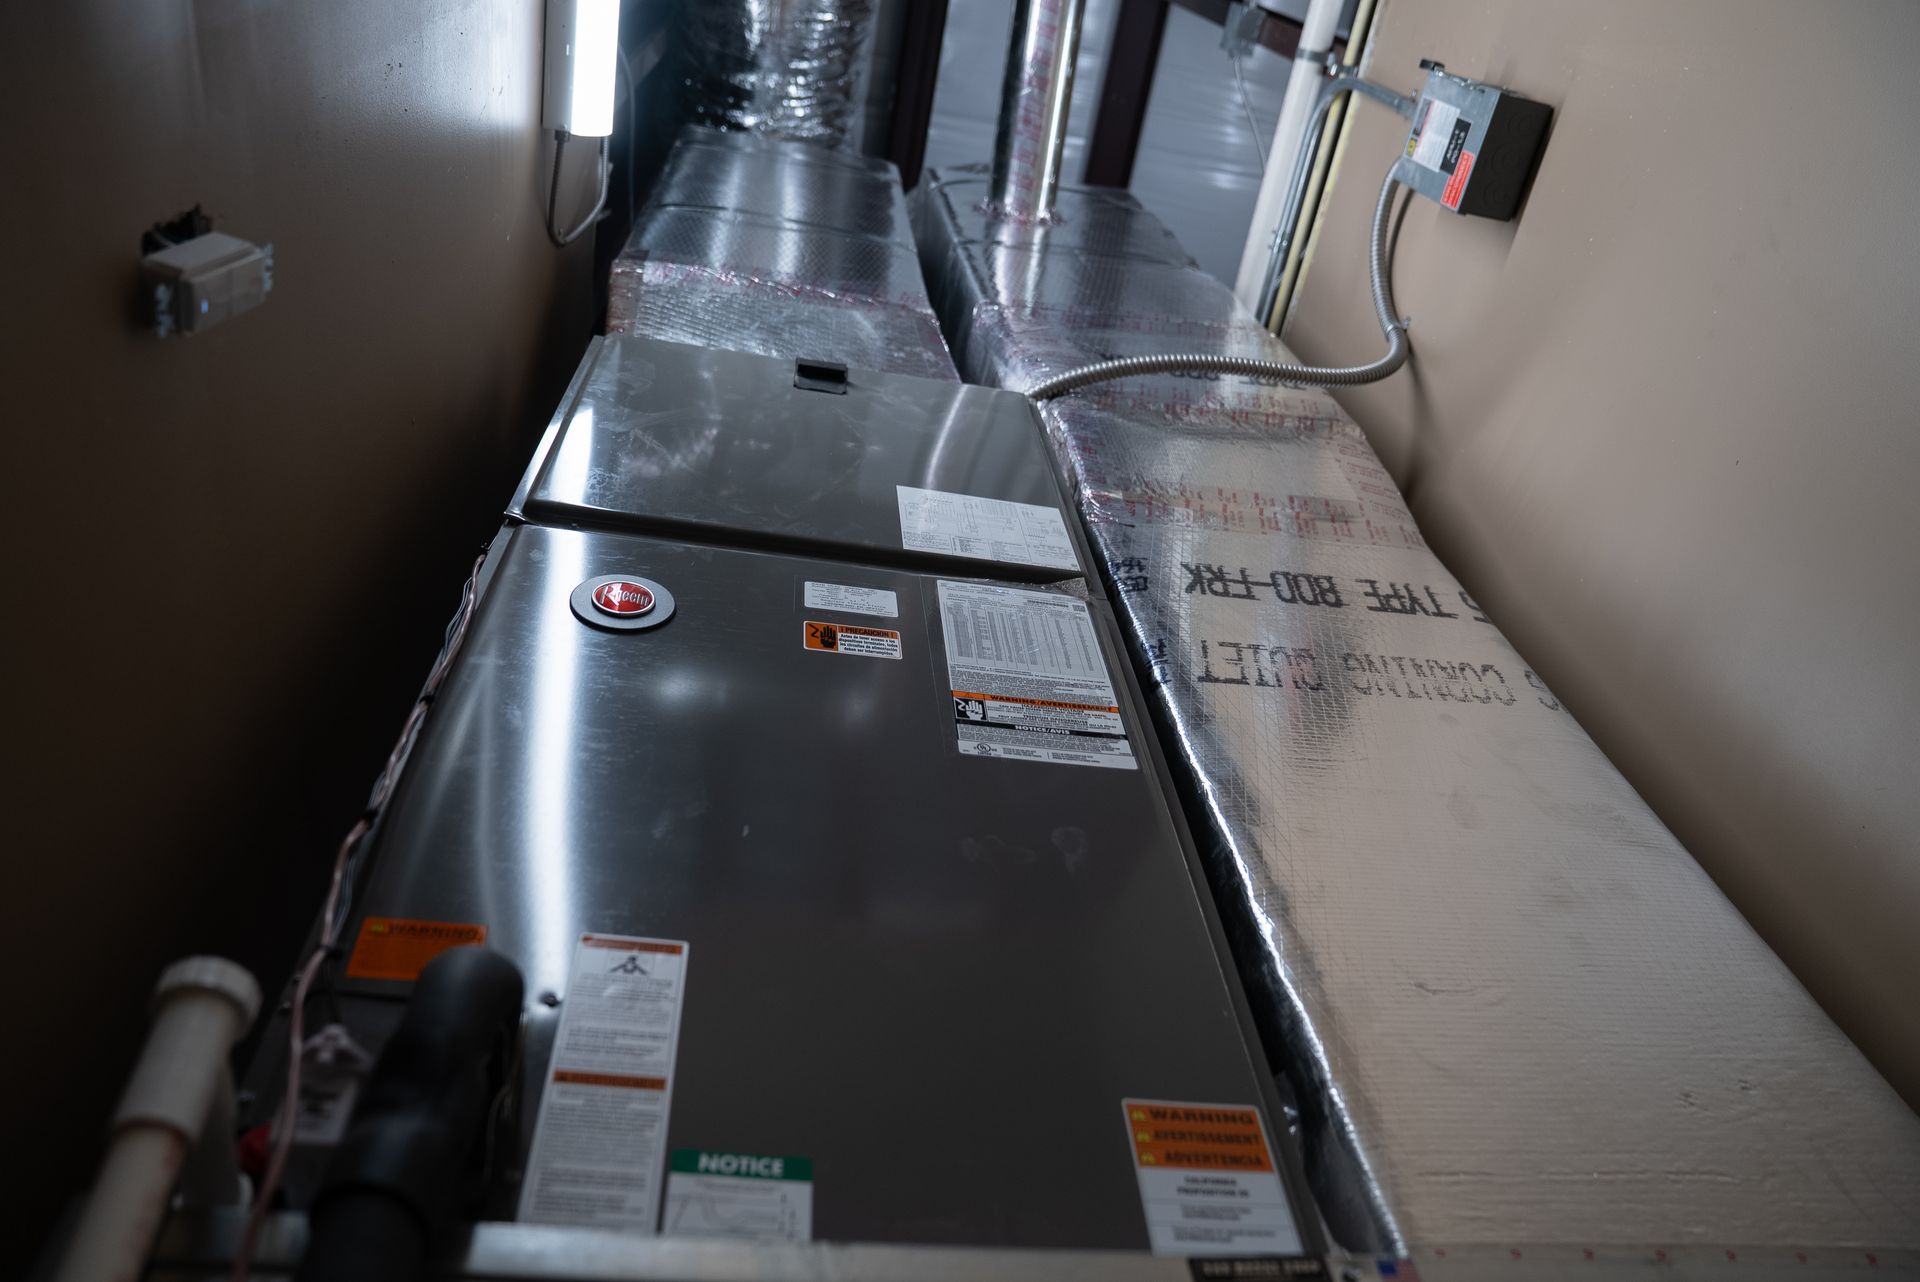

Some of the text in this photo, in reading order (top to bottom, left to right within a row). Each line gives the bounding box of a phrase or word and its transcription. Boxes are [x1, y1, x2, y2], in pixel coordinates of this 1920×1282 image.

[1181, 562, 1350, 608] 800-FRK
[1355, 577, 1459, 620] TYPE
[1344, 652, 1517, 706] CORNING
[388, 923, 479, 940] WARNING
[1150, 1109, 1254, 1124] WARNING
[698, 1152, 784, 1177] NOTICE
